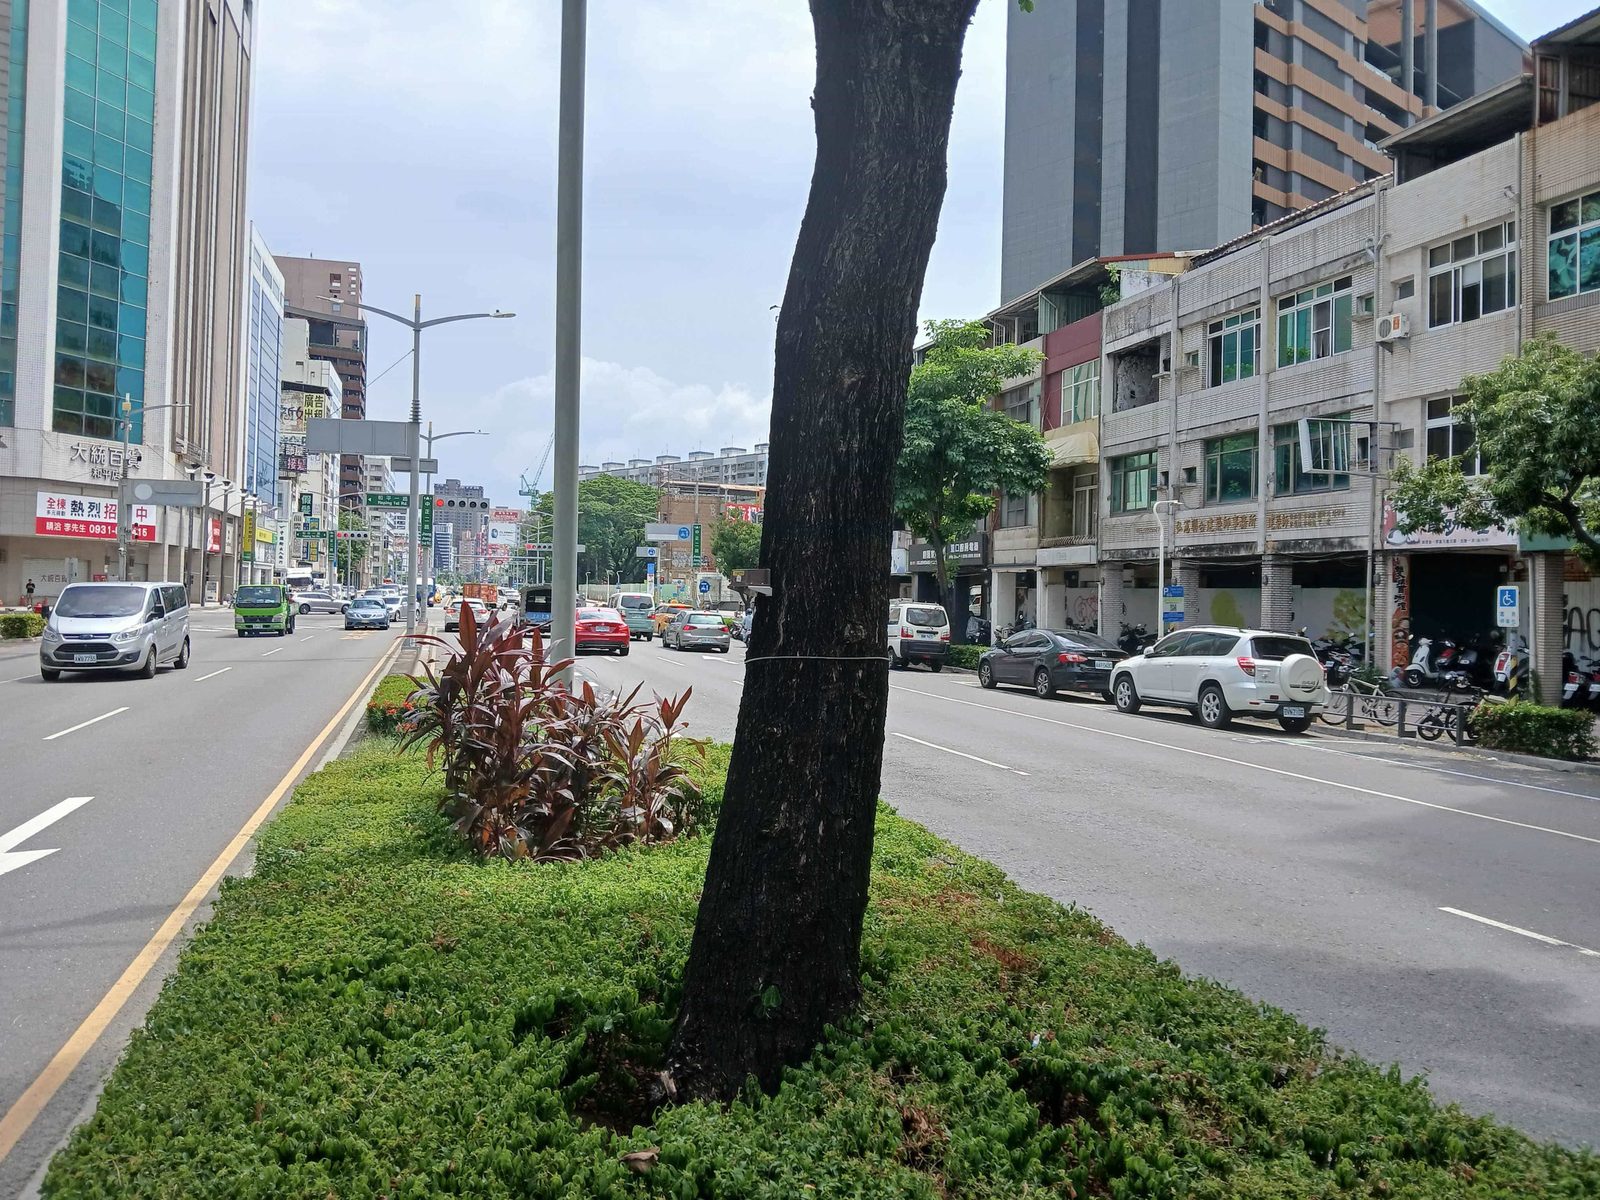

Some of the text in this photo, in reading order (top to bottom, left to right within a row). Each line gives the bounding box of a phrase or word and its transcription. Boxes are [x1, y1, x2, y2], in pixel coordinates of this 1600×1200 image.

[304, 394, 324, 408] 廣告
[71, 443, 142, 470] 大統百貨
[47, 497, 66, 510] 全棟
[70, 500, 148, 522] 熱烈招中
[64, 523, 87, 533] 李先生
